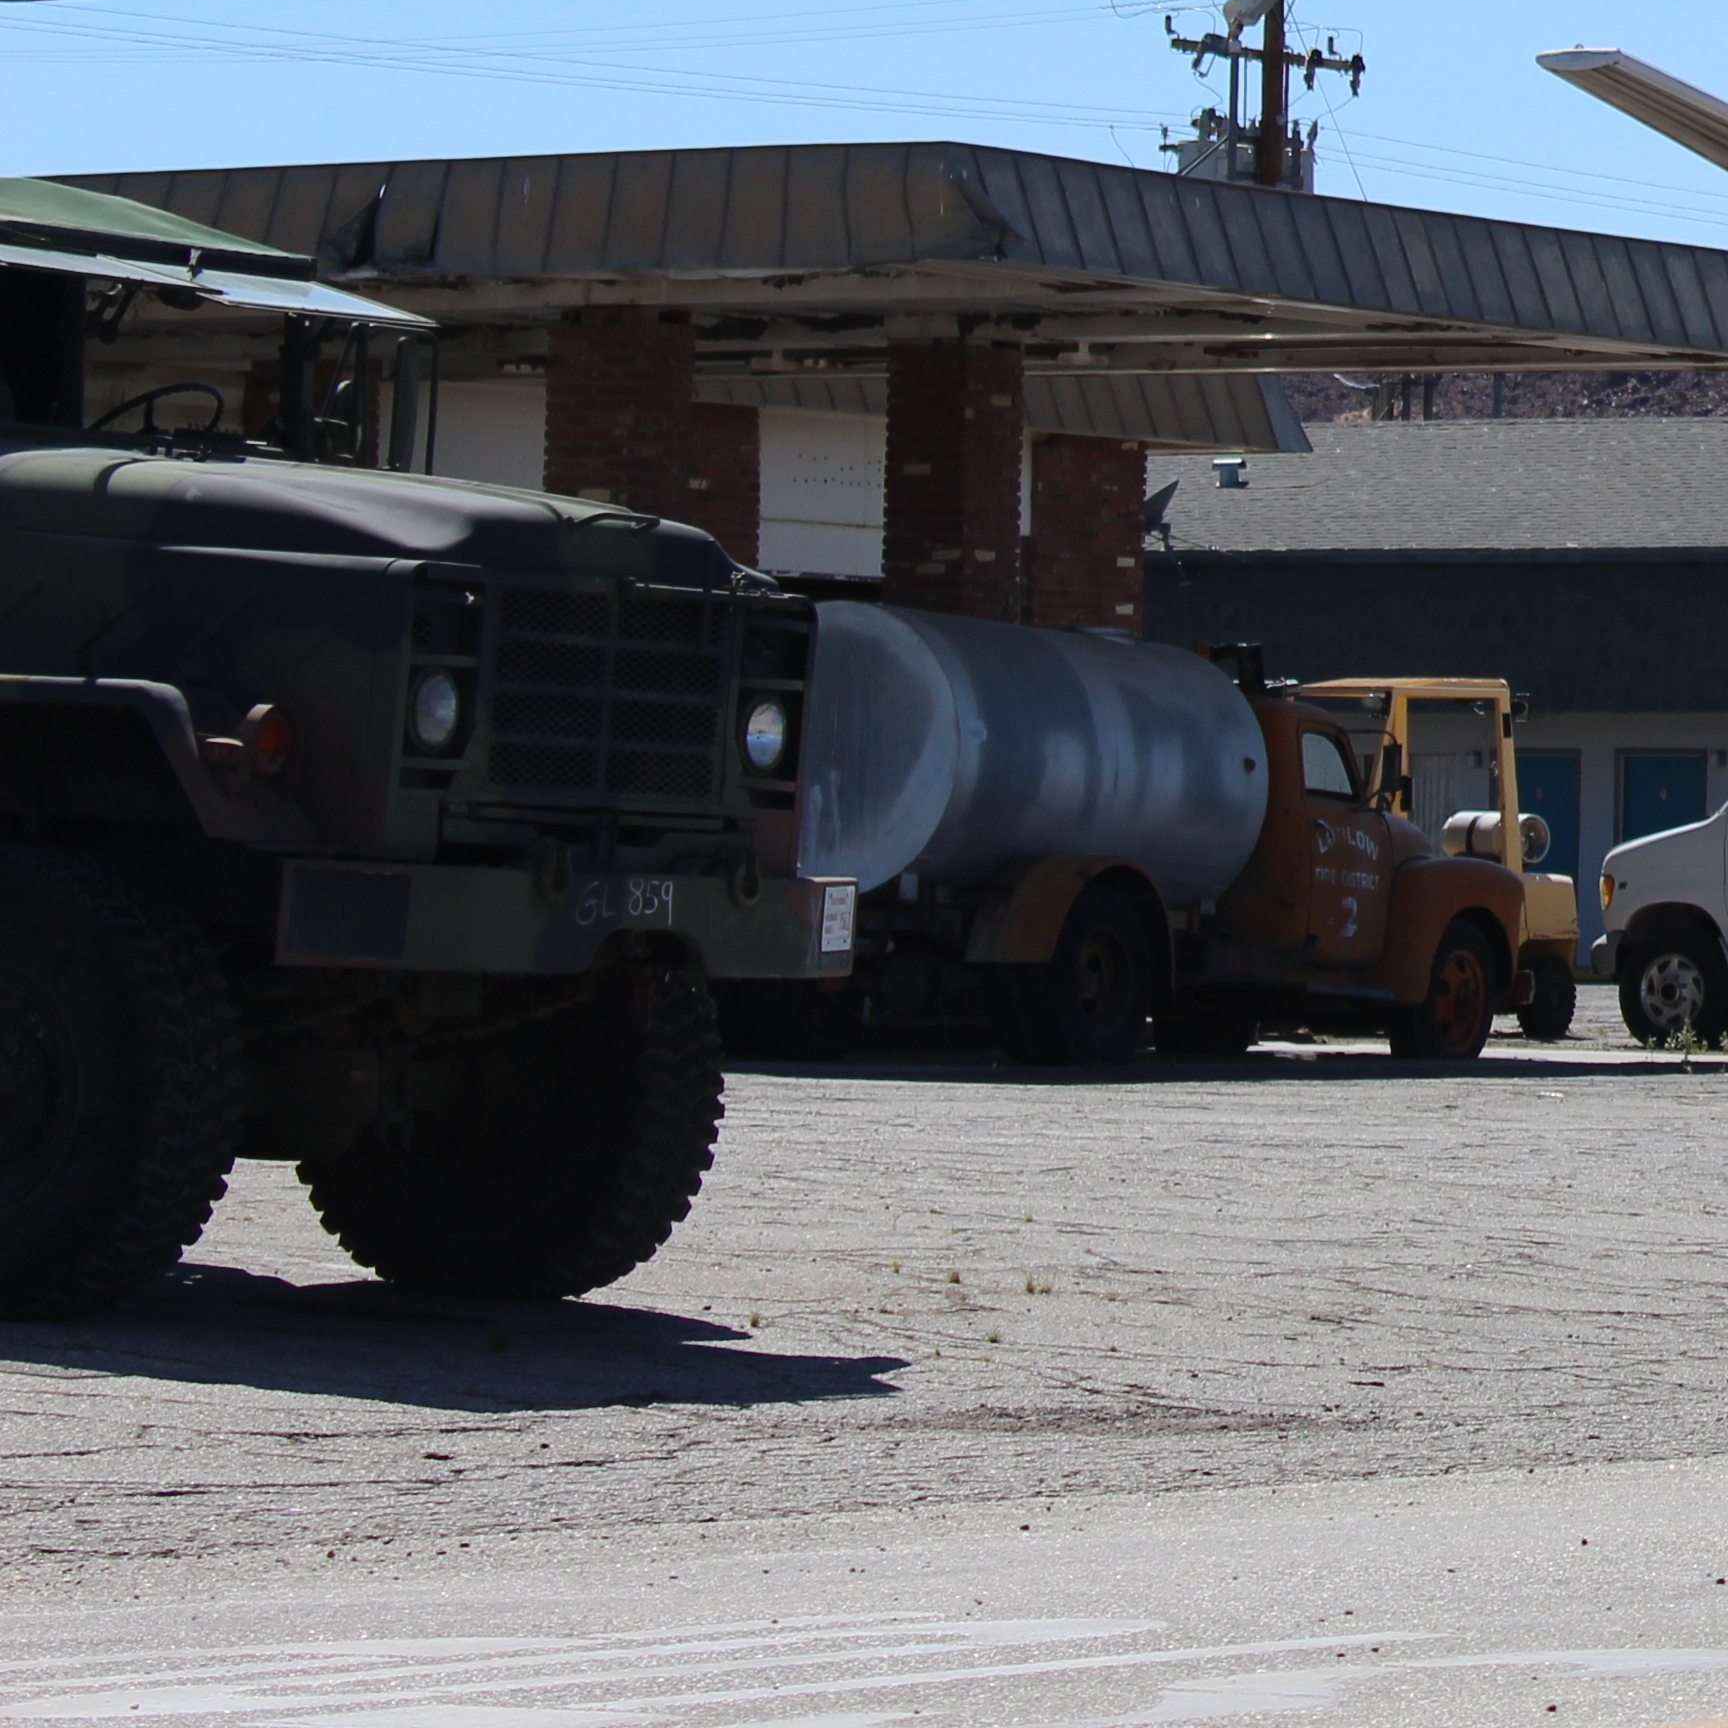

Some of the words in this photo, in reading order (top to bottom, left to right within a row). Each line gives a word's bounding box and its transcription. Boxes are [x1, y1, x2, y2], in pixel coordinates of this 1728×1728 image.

[1341, 870, 1380, 890] DISTRICT
[576, 881, 617, 926] GL
[627, 878, 674, 926] 859
[1340, 896, 1358, 938] 2
